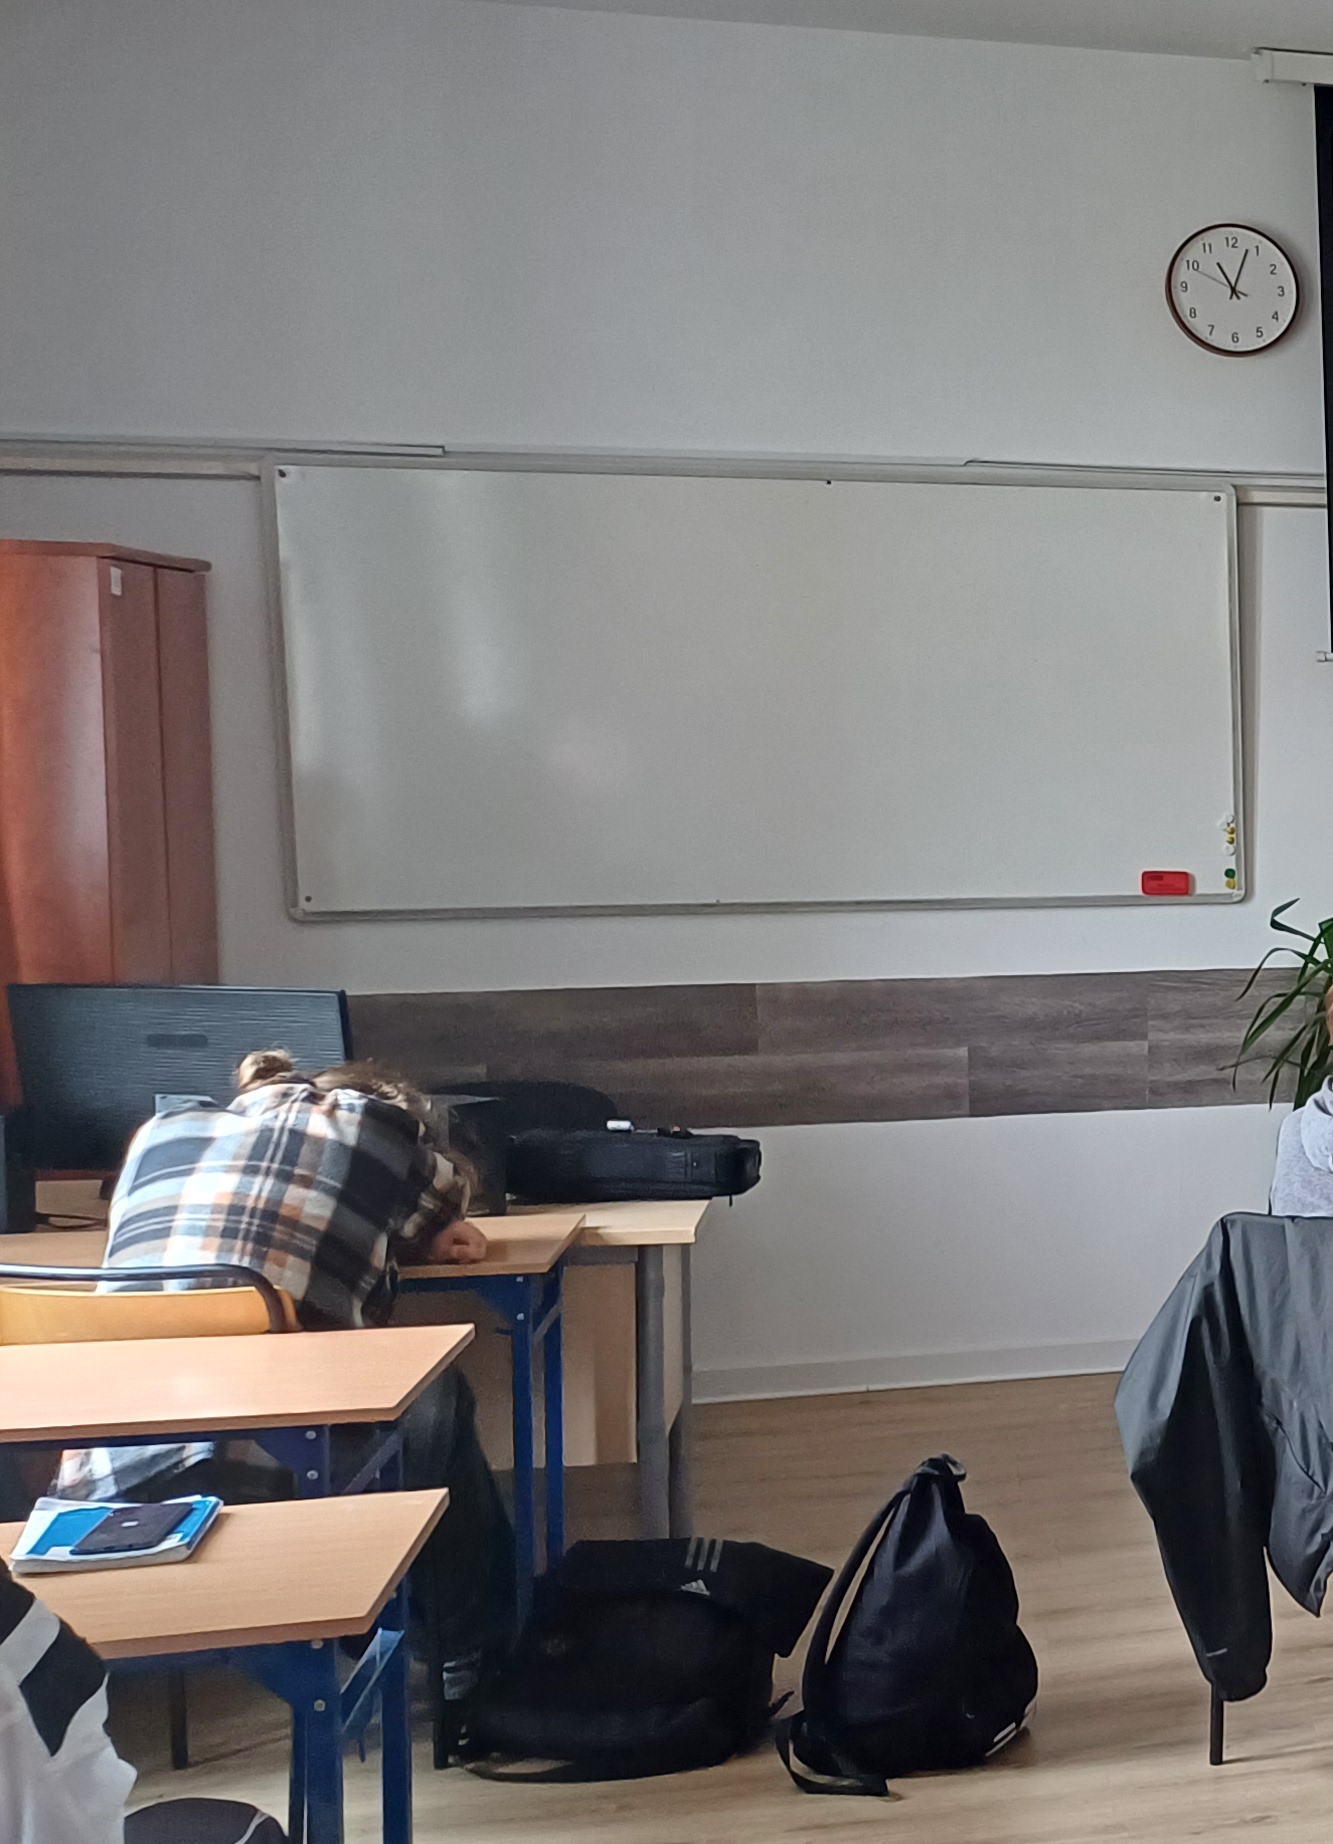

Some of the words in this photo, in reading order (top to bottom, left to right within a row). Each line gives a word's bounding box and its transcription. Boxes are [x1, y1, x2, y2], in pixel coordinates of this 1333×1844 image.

[1202, 242, 1212, 254] 11
[1224, 236, 1239, 249] 12
[1254, 245, 1259, 257] 1
[1185, 259, 1199, 271] 10
[1269, 263, 1277, 275] 2
[1180, 280, 1188, 293] 9
[1276, 285, 1285, 297] 3
[1189, 306, 1197, 319] 8
[1271, 310, 1279, 322] 4
[1207, 324, 1215, 336] 7
[1255, 326, 1264, 338] 5
[1231, 331, 1239, 343] 6
